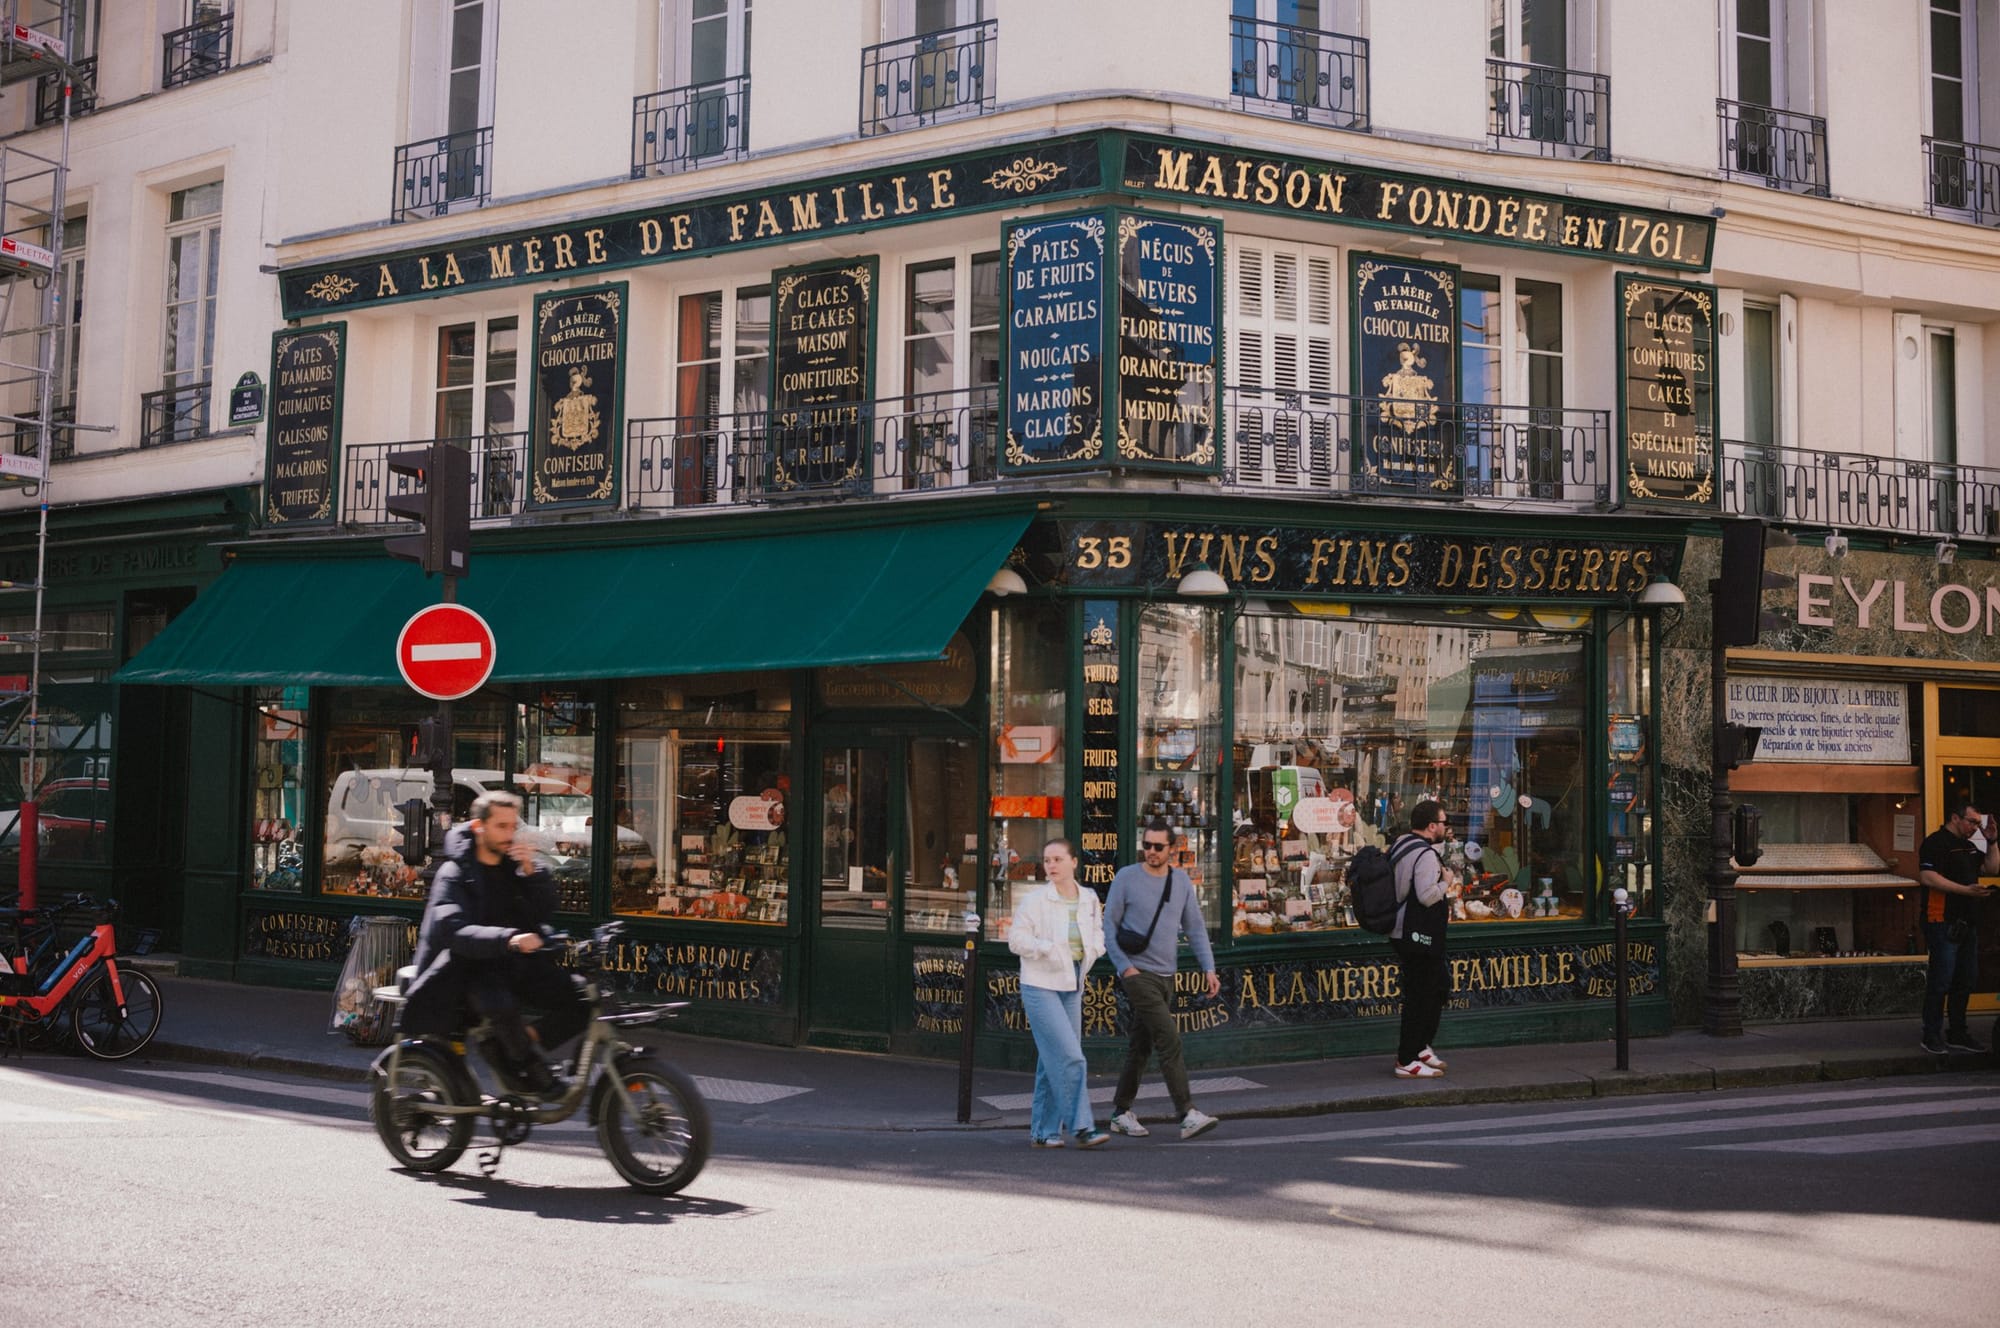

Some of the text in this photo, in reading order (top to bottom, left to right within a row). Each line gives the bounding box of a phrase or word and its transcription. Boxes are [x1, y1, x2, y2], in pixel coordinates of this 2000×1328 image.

[1154, 149, 1684, 260] MAISON FONDÉE EN 1761
[376, 263, 398, 297] A
[419, 252, 464, 290] LA
[638, 214, 693, 255] DE
[727, 169, 955, 242] FAMILLE
[1032, 238, 1079, 264] PÂTES
[1141, 238, 1194, 265] NÉGUS
[1017, 262, 1095, 291] DE FRUITS
[1161, 266, 1173, 278] DE
[1403, 271, 1411, 283] A
[798, 285, 849, 309] GLACES
[1137, 278, 1197, 305] NEVERS
[1382, 285, 1398, 297] LA
[576, 300, 583, 311] A
[1015, 300, 1097, 329] CARAMELS
[1373, 299, 1440, 319] DE FAMILLE
[559, 316, 571, 329] LA
[791, 306, 855, 331] ET CAKES
[1363, 316, 1450, 343] CHOCOLATIER
[1644, 311, 1693, 334] GLACES
[551, 326, 606, 345] DE FAMILLE
[797, 331, 848, 354] MAISON
[1120, 317, 1213, 346] FLORENTINS
[541, 342, 614, 367] CHOCOLATIER
[1020, 343, 1090, 370] NOUGATS
[1633, 346, 1705, 372] CONFITURES
[281, 364, 333, 386] D'AMANDES
[783, 366, 859, 392] CONFITURES
[1120, 355, 1213, 384] ORANGETTES
[278, 394, 332, 417] GUIMAUVES
[1017, 385, 1092, 413] MARRONS
[1648, 384, 1692, 406] CAKES
[1125, 399, 1209, 425] MENDIANTS
[1664, 412, 1676, 428] ET
[278, 425, 328, 446] CALISSONS
[1025, 413, 1083, 439] GLACÉS
[1632, 430, 1708, 456] SPÉCIALITÉS
[276, 459, 328, 480] MACARONS
[544, 453, 604, 474] CONFISEUR
[1648, 458, 1694, 479] MAISON
[281, 488, 320, 507] TRUFFES
[122, 545, 195, 573] FAMILLE
[1078, 536, 1132, 569] 35
[1163, 531, 1652, 593] VINS FINS DESSERTS
[1798, 573, 2000, 637] EYLO
[1084, 664, 1118, 684] FRUITS
[1088, 698, 1113, 716] SECS
[1730, 684, 1742, 701] LE
[1782, 687, 1800, 703] DES
[1803, 687, 1839, 708] BIJOUX
[1848, 689, 1862, 705] LA
[1864, 689, 1900, 707] PIERRE
[1730, 708, 1745, 720] Des
[1748, 710, 1774, 723] pierres
[1843, 712, 1852, 723] de
[1854, 712, 1872, 725] belle
[1875, 713, 1901, 730] qualité
[1760, 725, 1894, 740] onseils de votre bijoutier spécialiste
[1762, 738, 1873, 754] Réparation de bijoux anciens
[1083, 749, 1118, 767] FRUITS
[1083, 781, 1116, 799] CONFITS
[1082, 833, 1118, 851] CHOCOLATS
[261, 912, 338, 937] CONFISERIE
[266, 938, 331, 960] DESSERTS
[666, 945, 752, 972] FABRIQUE
[1582, 943, 1655, 968] CONFERIE
[701, 968, 714, 977] DE
[915, 959, 965, 978] FOURS SEC
[1267, 971, 1310, 1006] LA
[1315, 961, 1401, 1003] MÈRE
[1451, 951, 1575, 993] FAMILLE
[657, 972, 760, 1000] CONFITURES
[916, 987, 933, 1001] PAIN
[1175, 971, 1213, 994] RIQU
[1587, 973, 1653, 997] DESRTS
[1178, 996, 1189, 1007] DE
[1357, 1004, 1392, 1017] MAISON
[917, 1014, 940, 1032] FOURS
[1003, 1009, 1031, 1031] MIE
[1169, 1003, 1229, 1033] ITURES
